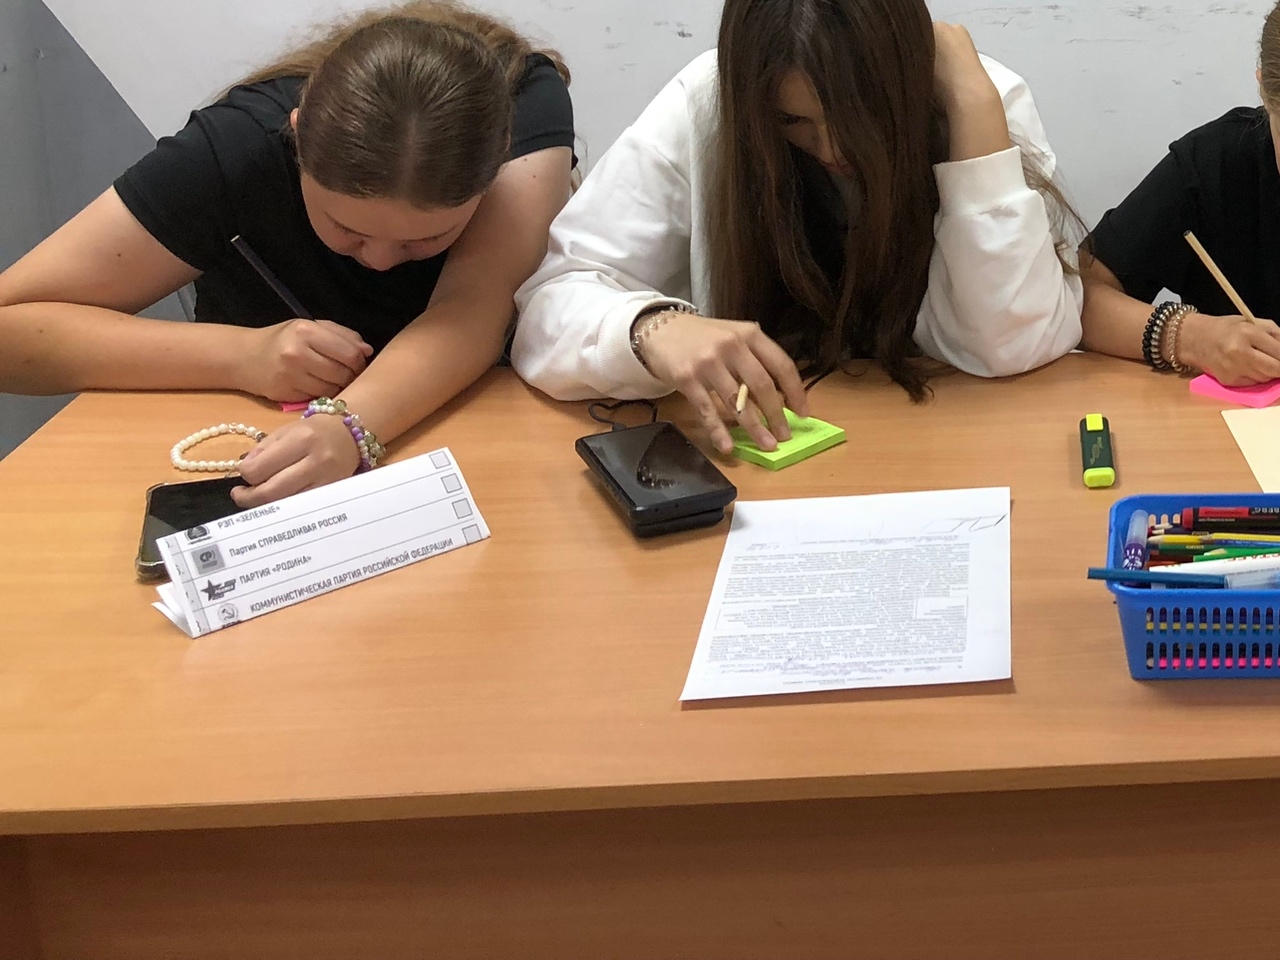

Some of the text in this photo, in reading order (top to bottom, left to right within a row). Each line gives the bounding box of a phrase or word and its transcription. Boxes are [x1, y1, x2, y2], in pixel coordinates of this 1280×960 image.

[229, 513, 348, 557] Партия СПРАВЕДЛИВАЯ РОССИЯ
[239, 555, 312, 584] ПАРТИЯ «РОДИНА»
[250, 579, 333, 613] КОММУНИСТИЧЕСКАЯ
[333, 568, 362, 585] ПАРТИЯ
[362, 551, 411, 575] РОССИЙСКОЙ
[410, 538, 454, 559] ФЕДЕРАЦИИ
